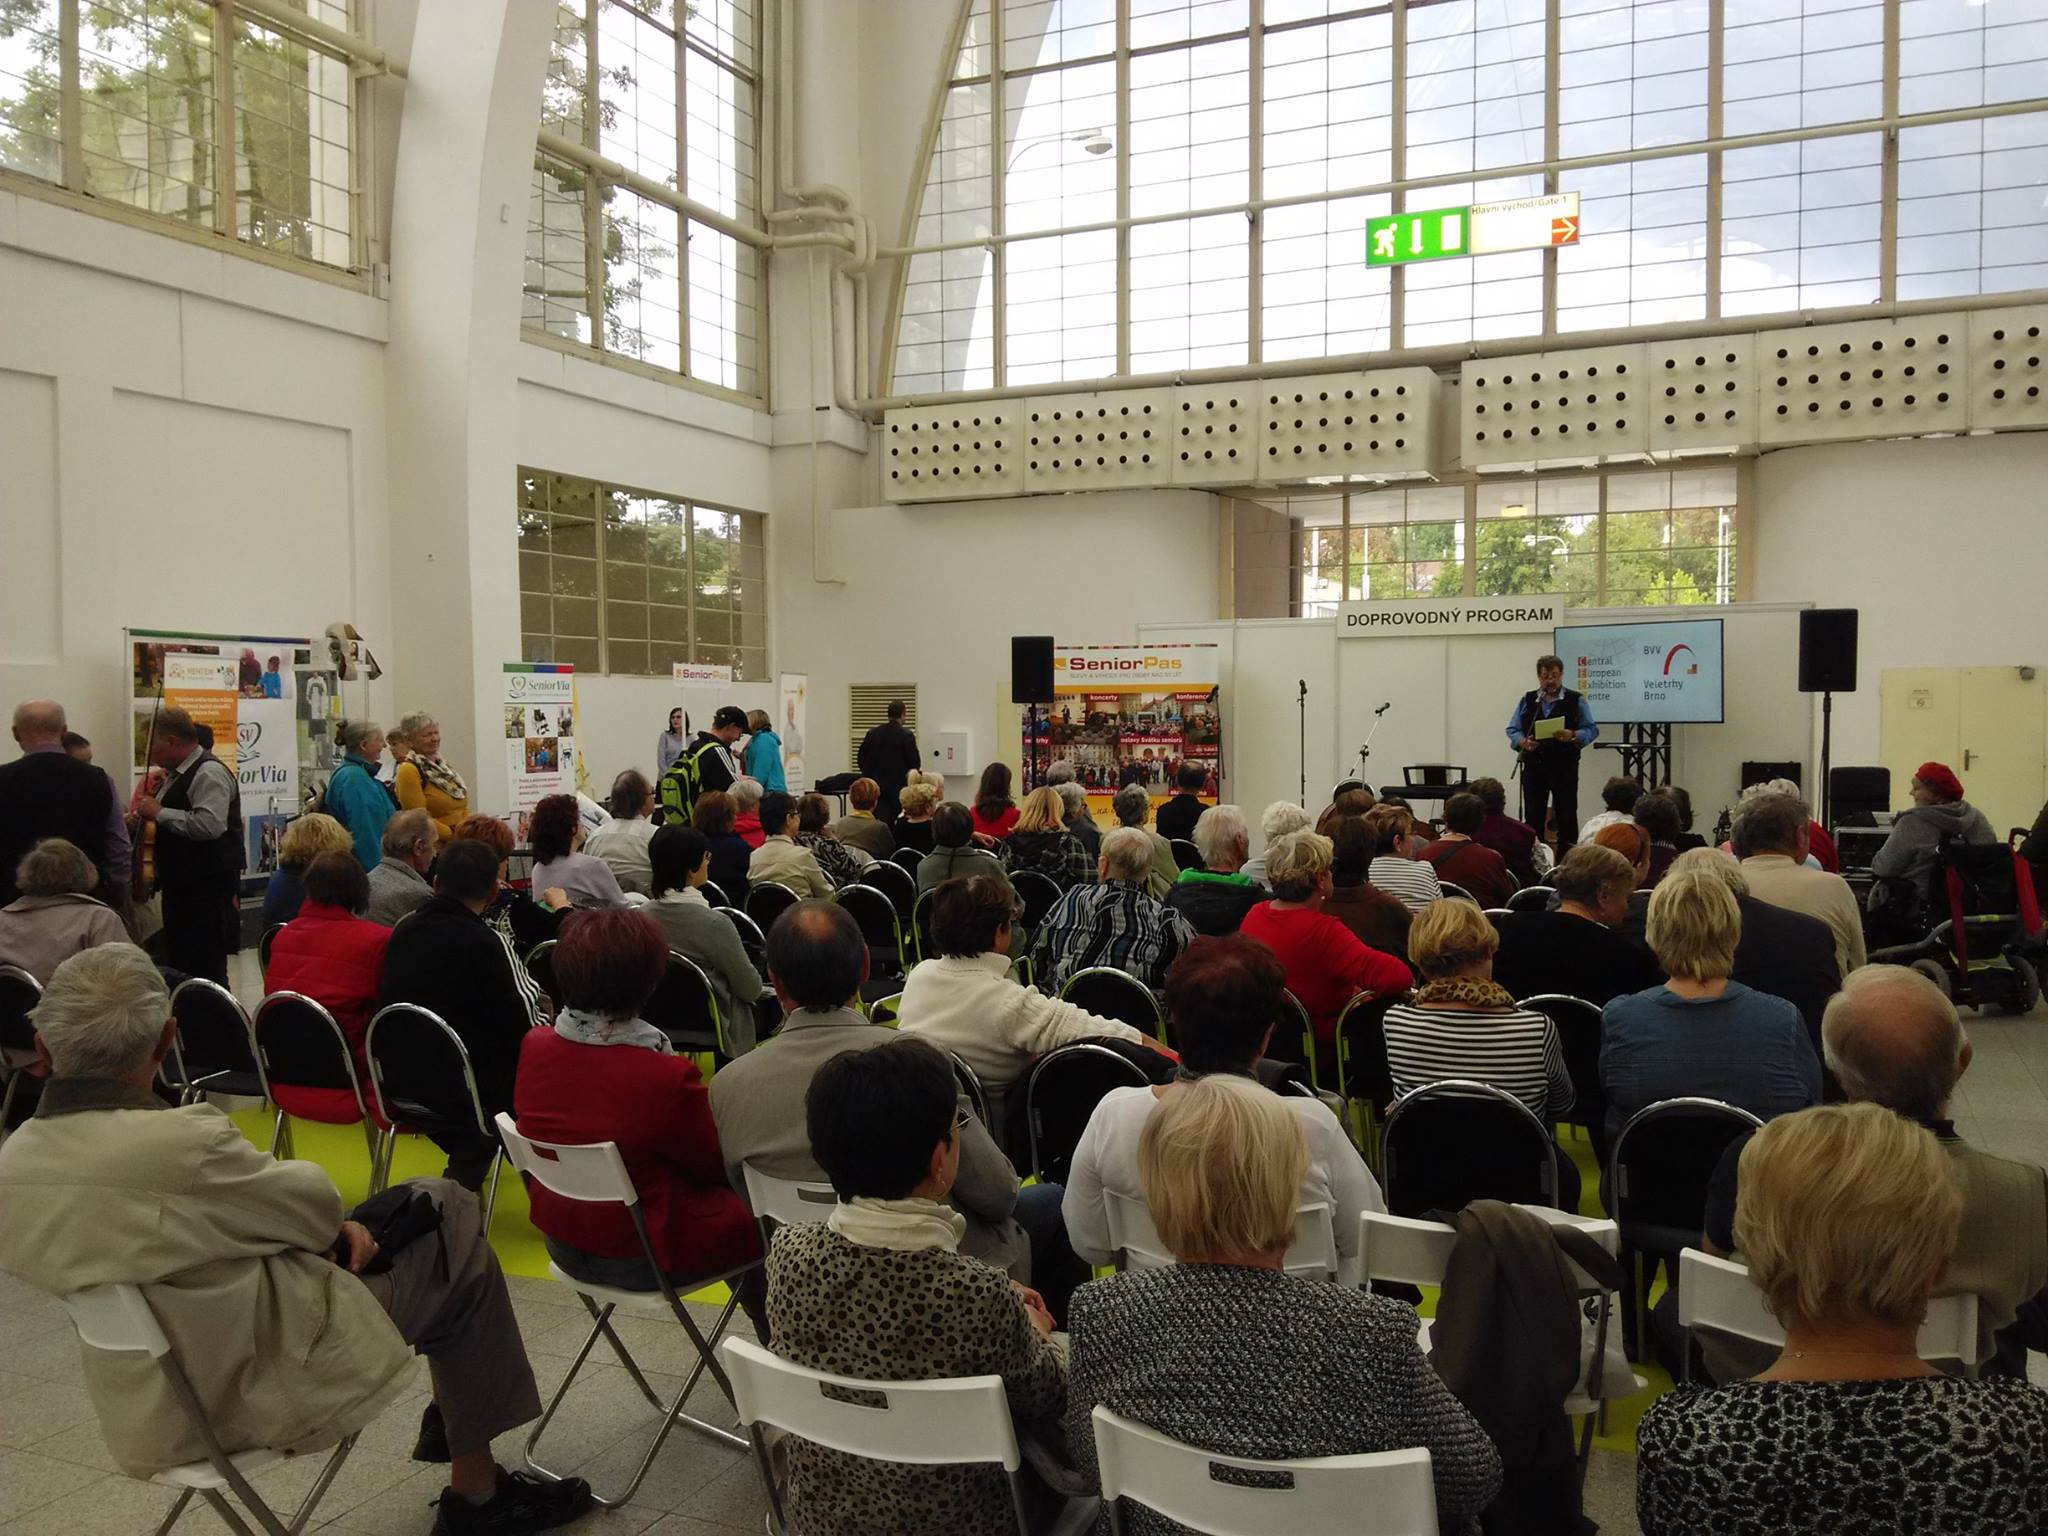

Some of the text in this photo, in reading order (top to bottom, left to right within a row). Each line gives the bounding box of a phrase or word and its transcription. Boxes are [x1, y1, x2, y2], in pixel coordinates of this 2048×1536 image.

[1347, 608, 1553, 627] DOPROVODNÝ PROGRAM
[1643, 645, 1662, 655] BVV
[1069, 656, 1182, 671] SeniorPas
[1643, 679, 1684, 690] Veletrhy
[1643, 692, 1666, 700] Brno
